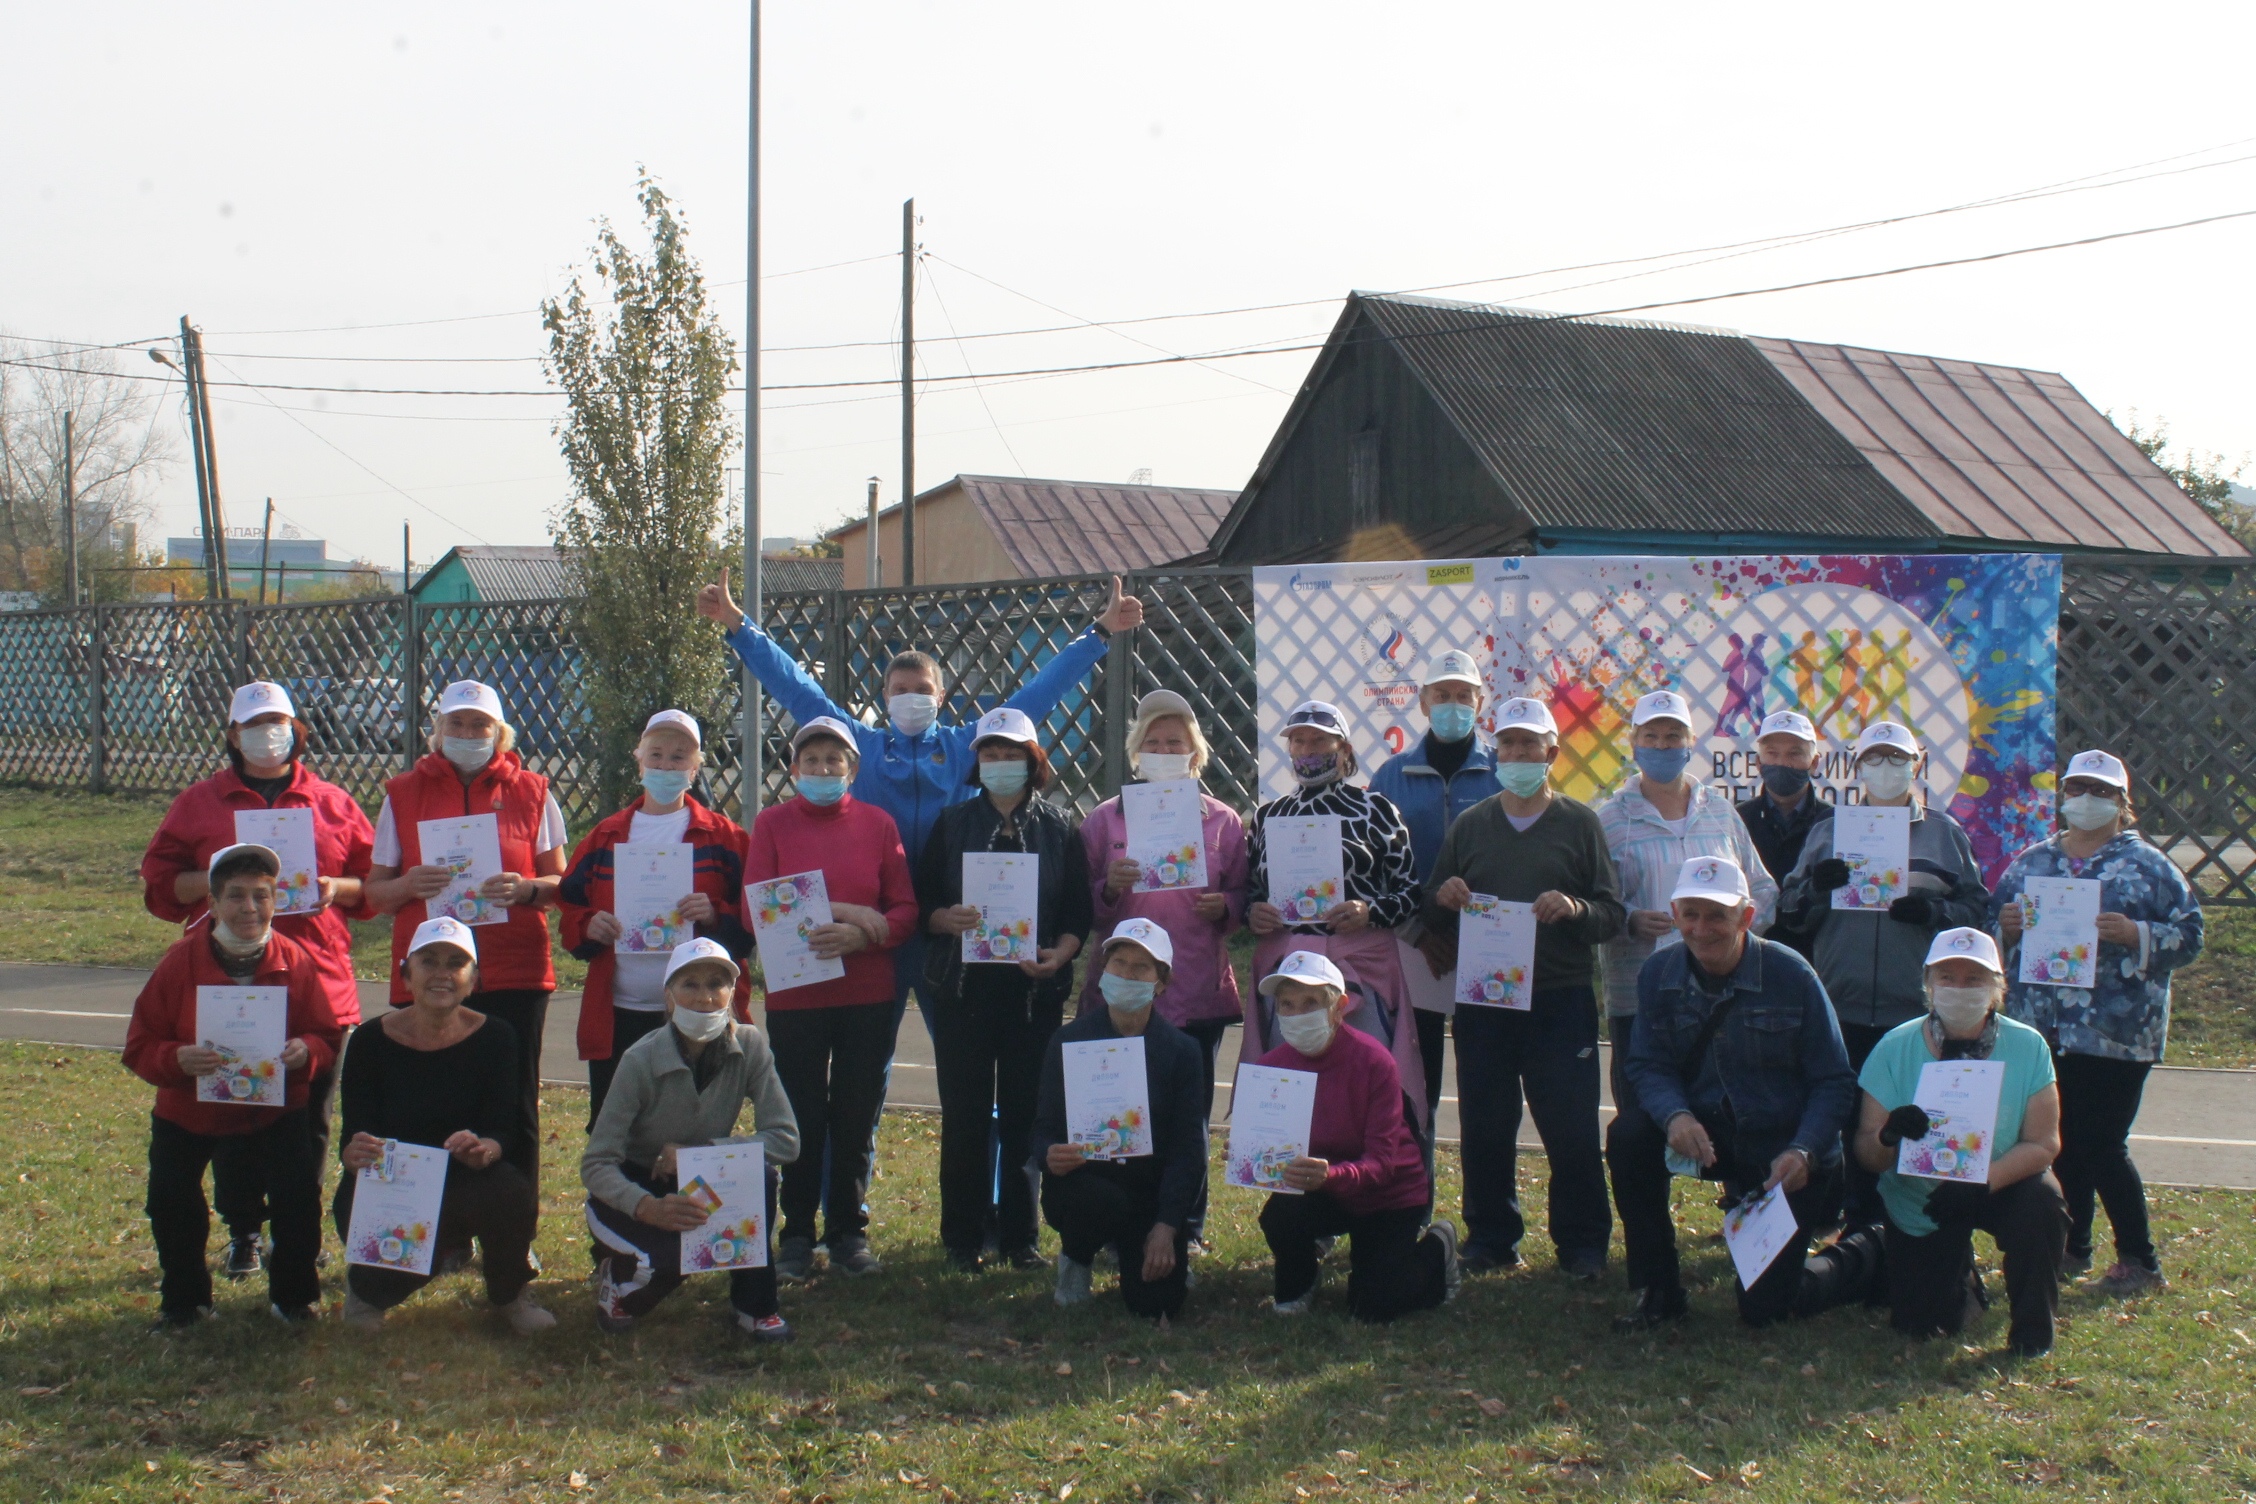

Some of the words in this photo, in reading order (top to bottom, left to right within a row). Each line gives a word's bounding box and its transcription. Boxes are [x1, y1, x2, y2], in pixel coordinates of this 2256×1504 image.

[1429, 566, 1471, 578] ZASPORT
[1301, 579, 1332, 591] ГАЗПРОМ
[1363, 684, 1418, 697] ОЛИМПИЙСКАЯ
[1376, 697, 1406, 707] СТРАНА
[1929, 1130, 1946, 1138] 2021
